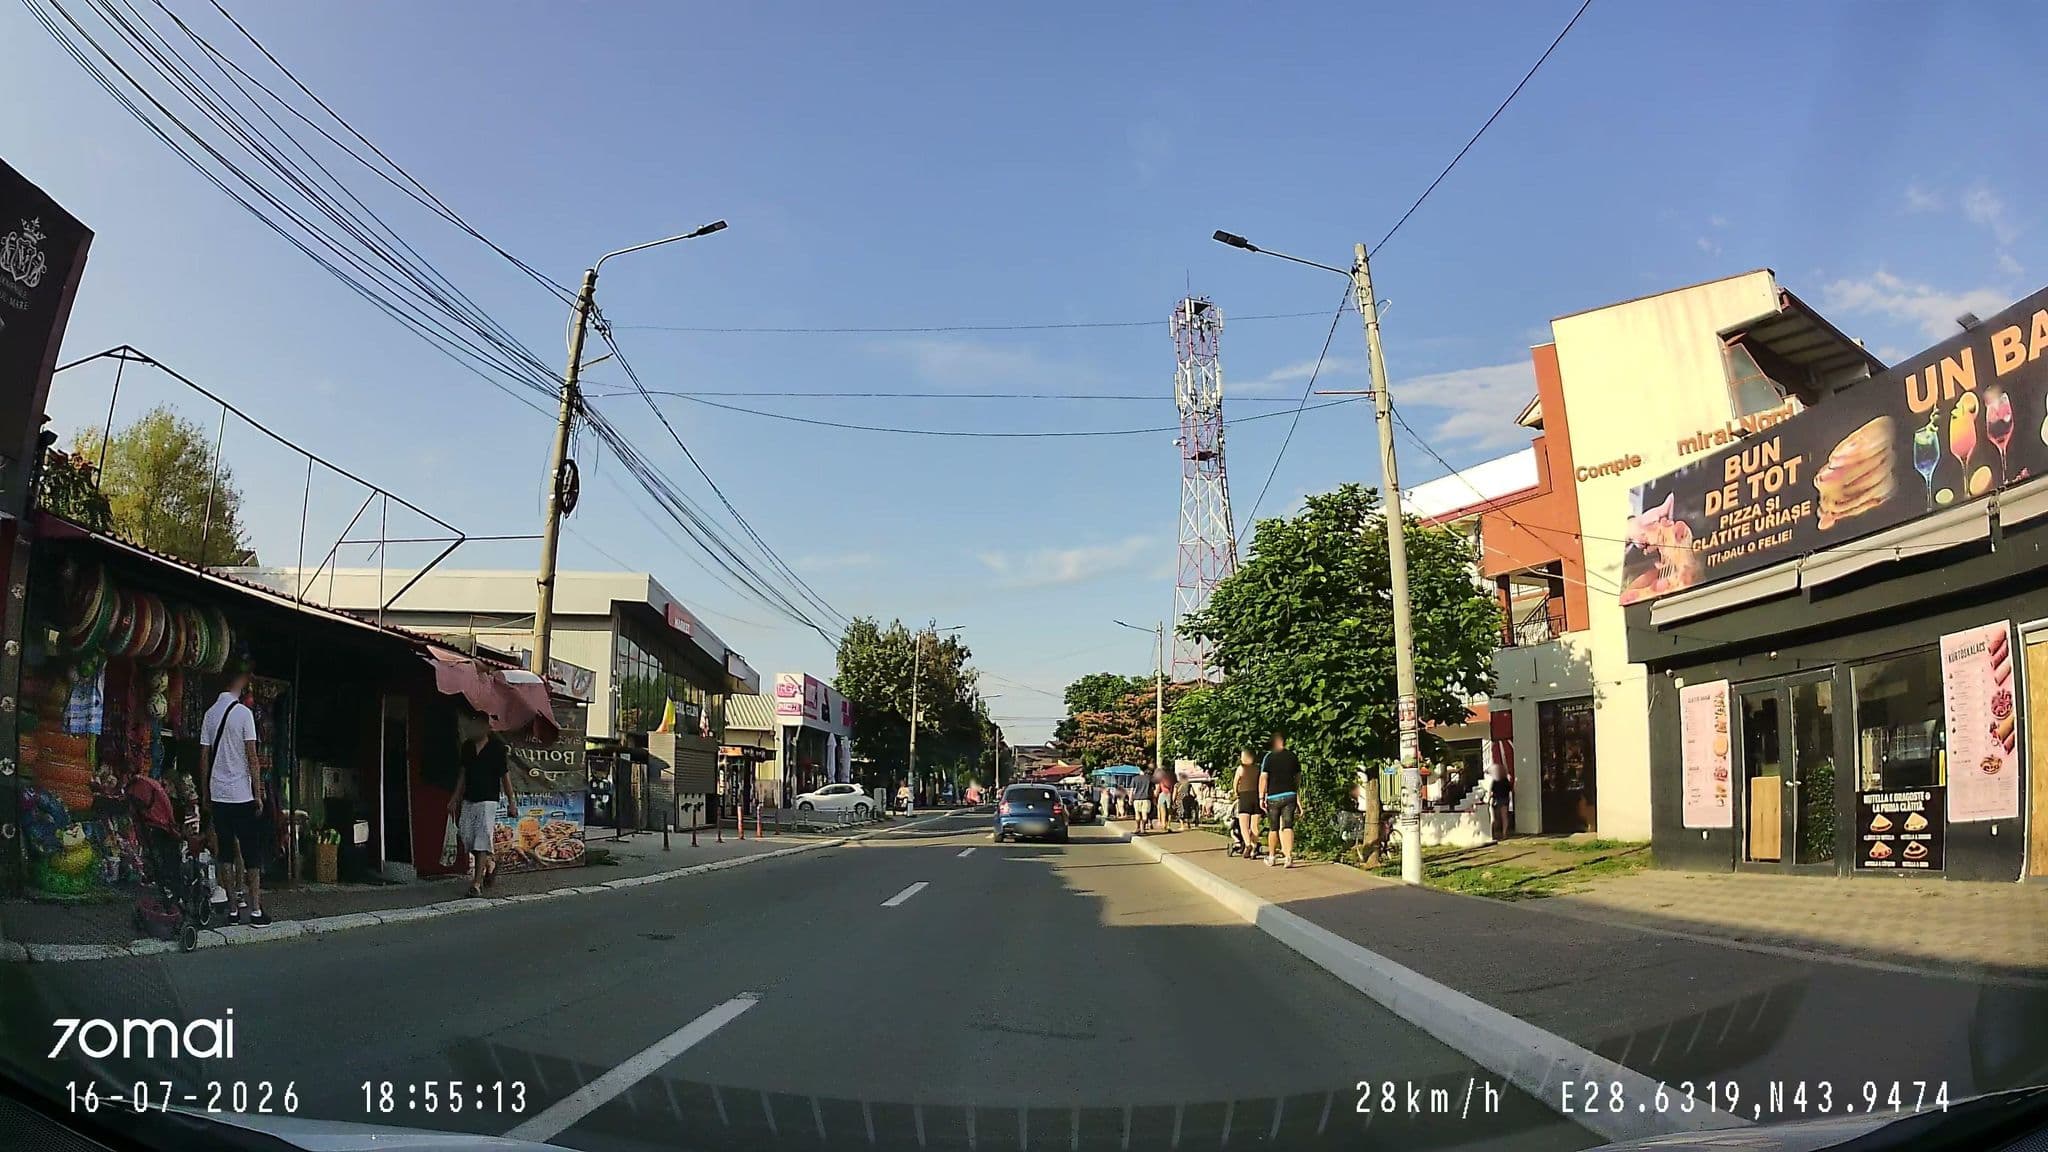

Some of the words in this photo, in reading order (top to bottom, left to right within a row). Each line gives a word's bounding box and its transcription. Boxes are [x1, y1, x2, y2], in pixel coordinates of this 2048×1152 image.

[1905, 346, 1977, 414] UN
[1575, 453, 1642, 483] Comple
[1677, 421, 1733, 456] miral
[1724, 436, 1780, 482] BUN
[1704, 481, 1739, 517] DE
[1747, 455, 1802, 499] TOT
[1720, 503, 1762, 530] PIZZA
[1747, 541, 1756, 552] O
